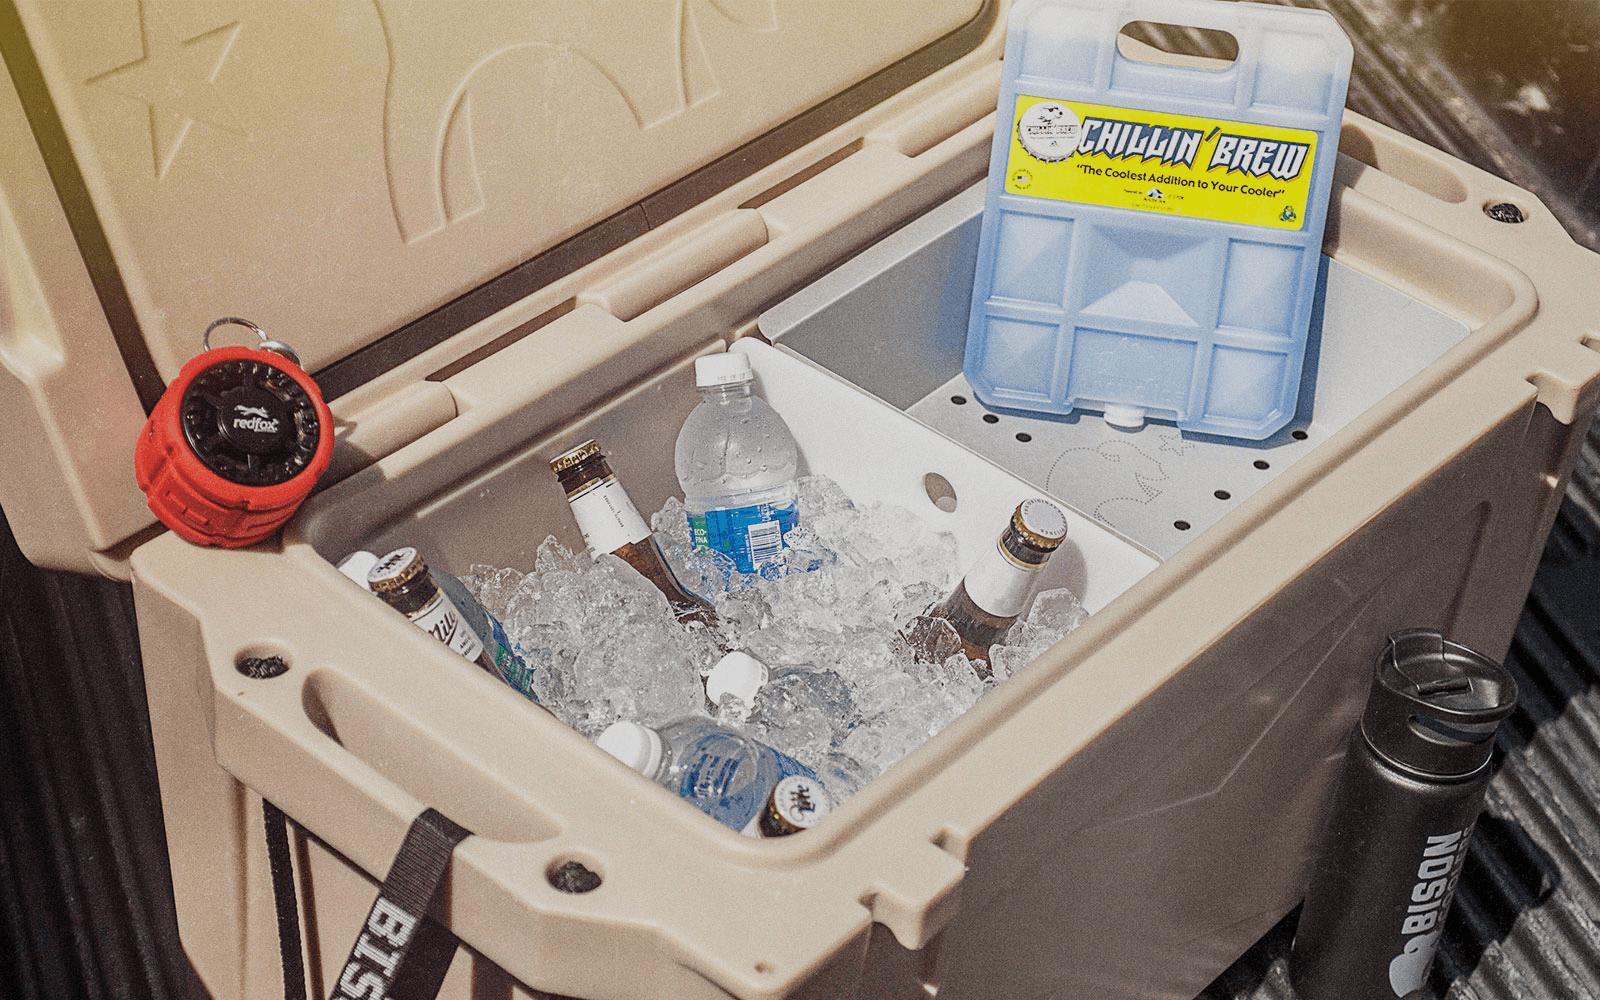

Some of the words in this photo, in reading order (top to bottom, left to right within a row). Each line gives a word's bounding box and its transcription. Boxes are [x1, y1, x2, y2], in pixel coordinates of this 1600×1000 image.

[1104, 167, 1147, 183] Coolest
[1148, 174, 1195, 189] Addition
[1198, 180, 1208, 190] to
[1211, 180, 1239, 195] Your
[1206, 132, 1310, 182] BREW
[233, 417, 278, 434] redfox
[1401, 831, 1462, 935] BISON
[334, 897, 418, 1000] BIS
